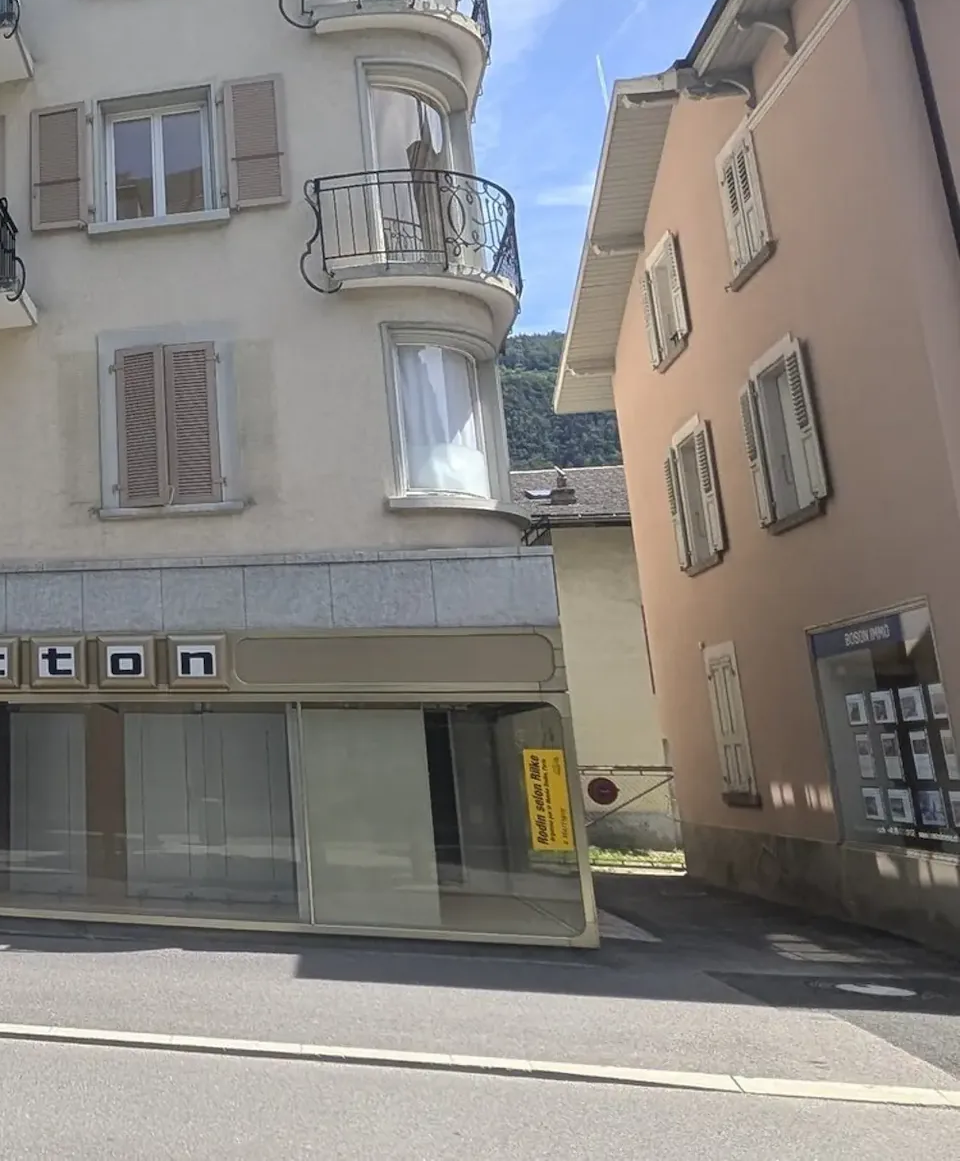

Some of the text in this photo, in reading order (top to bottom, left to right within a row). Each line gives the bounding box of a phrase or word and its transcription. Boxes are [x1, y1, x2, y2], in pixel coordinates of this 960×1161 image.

[530, 754, 541, 781] Rilke
[532, 783, 545, 813] selon
[536, 814, 549, 845] Rodin
